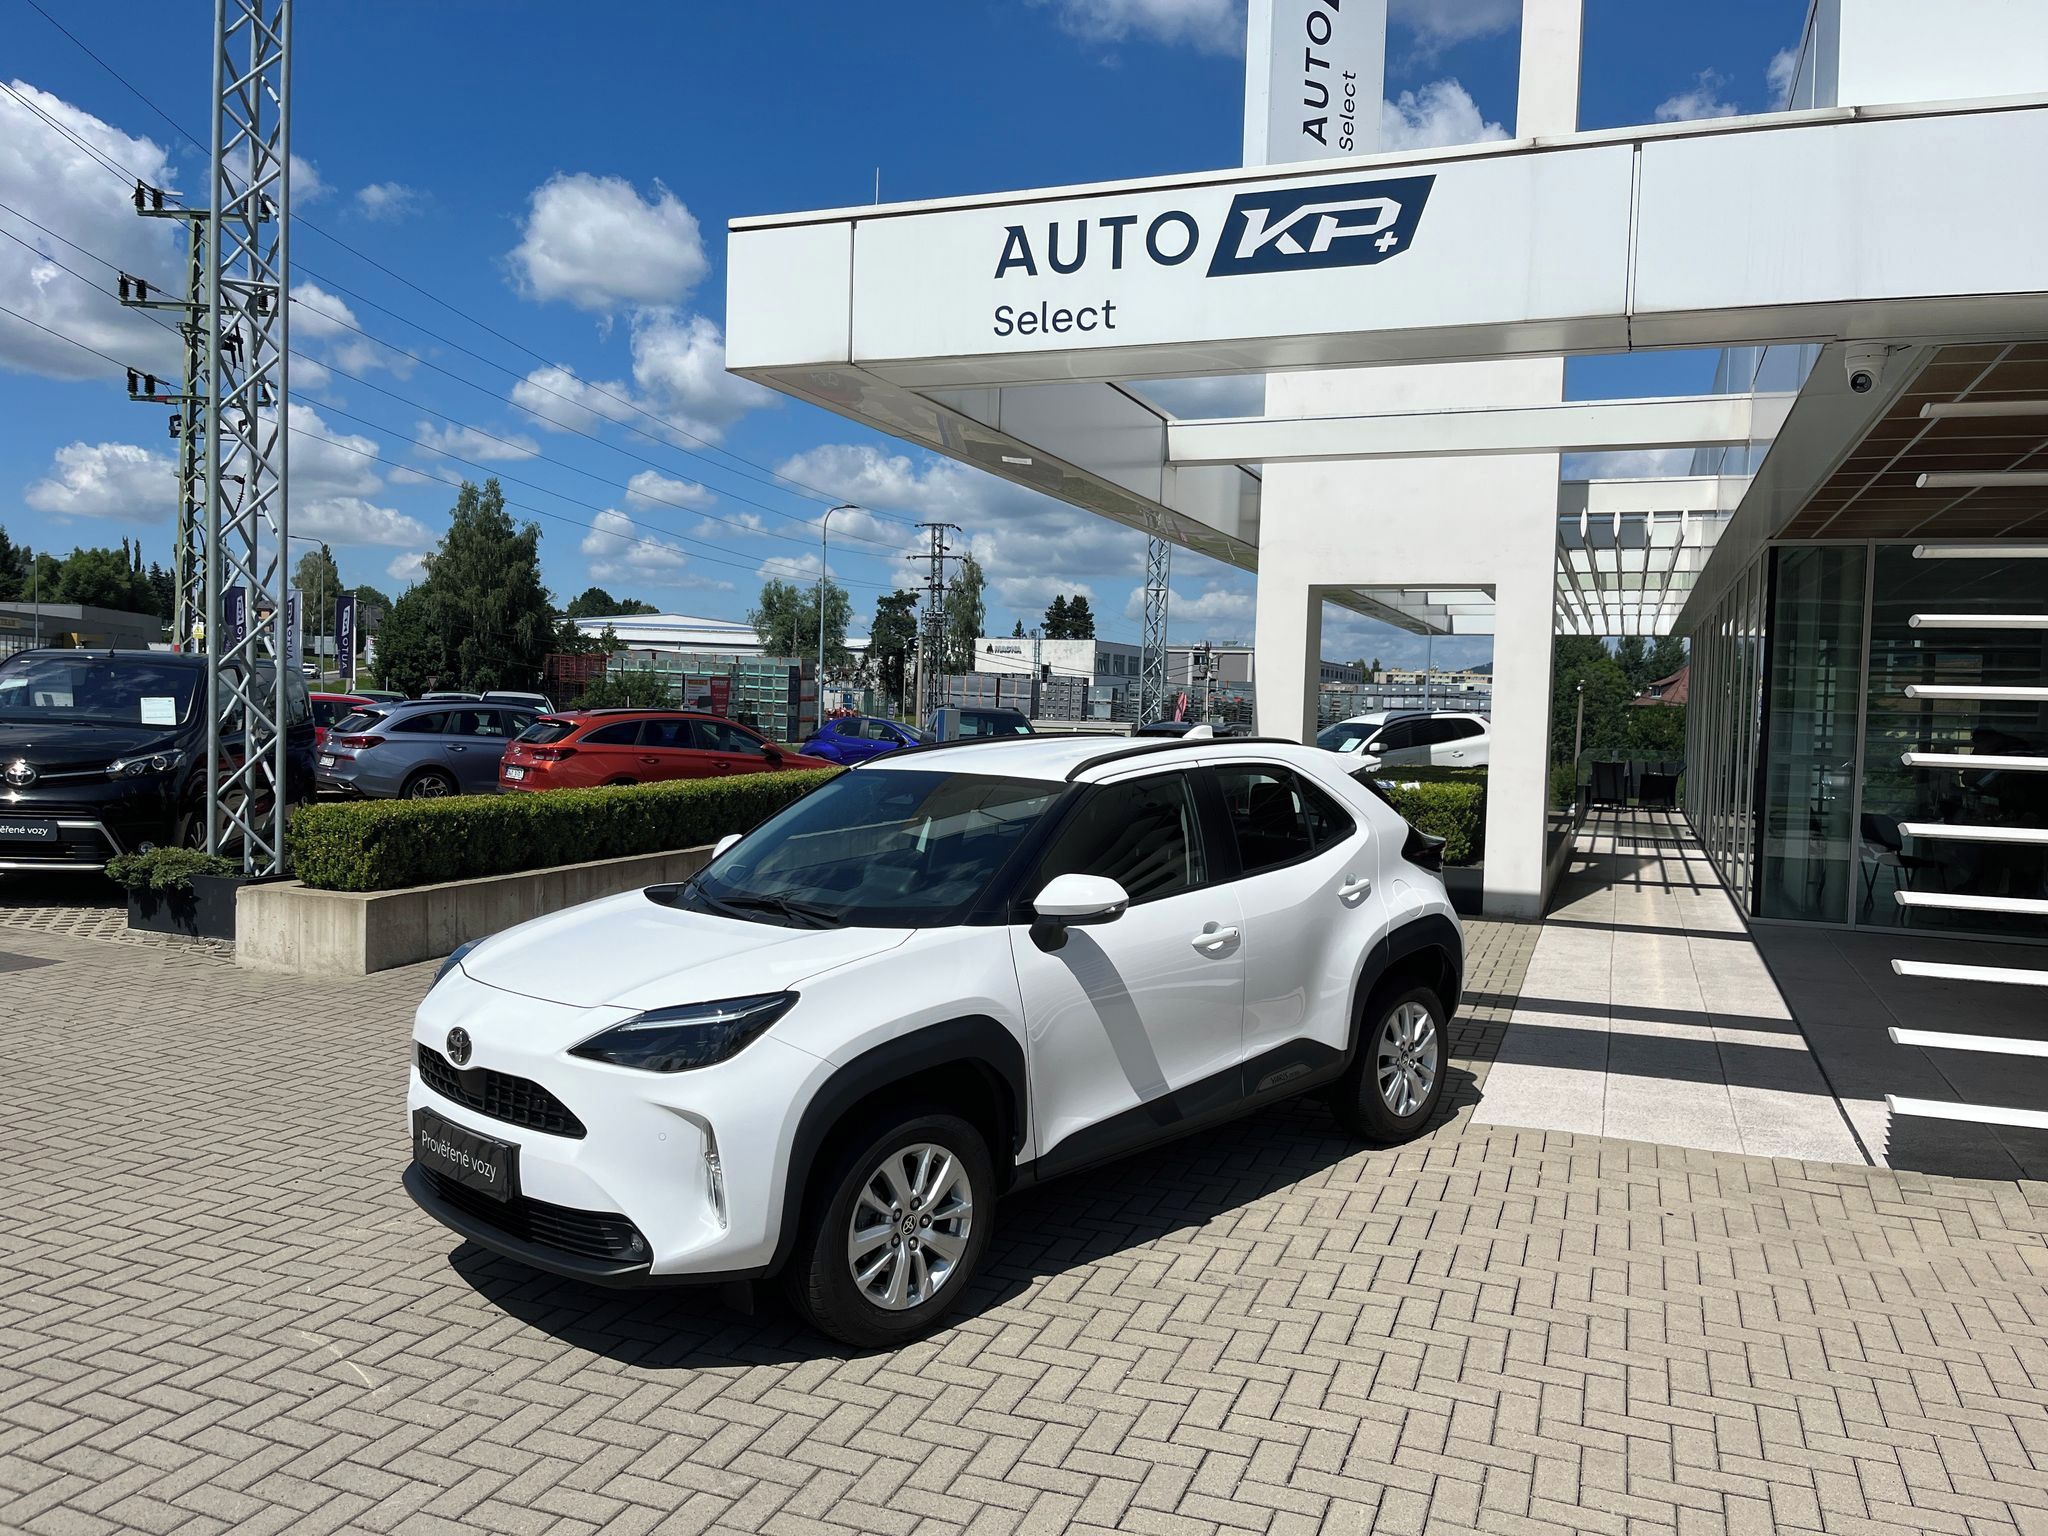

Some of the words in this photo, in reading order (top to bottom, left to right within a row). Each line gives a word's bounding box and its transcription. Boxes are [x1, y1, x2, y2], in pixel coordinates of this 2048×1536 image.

[1302, 10, 1332, 147] AUTO
[1338, 70, 1357, 152] Select
[993, 210, 1200, 279] AUTO
[993, 299, 1117, 337] Select
[27, 827, 49, 837] vozy
[421, 1129, 470, 1168] Prověřené
[471, 1157, 497, 1183] vozy
